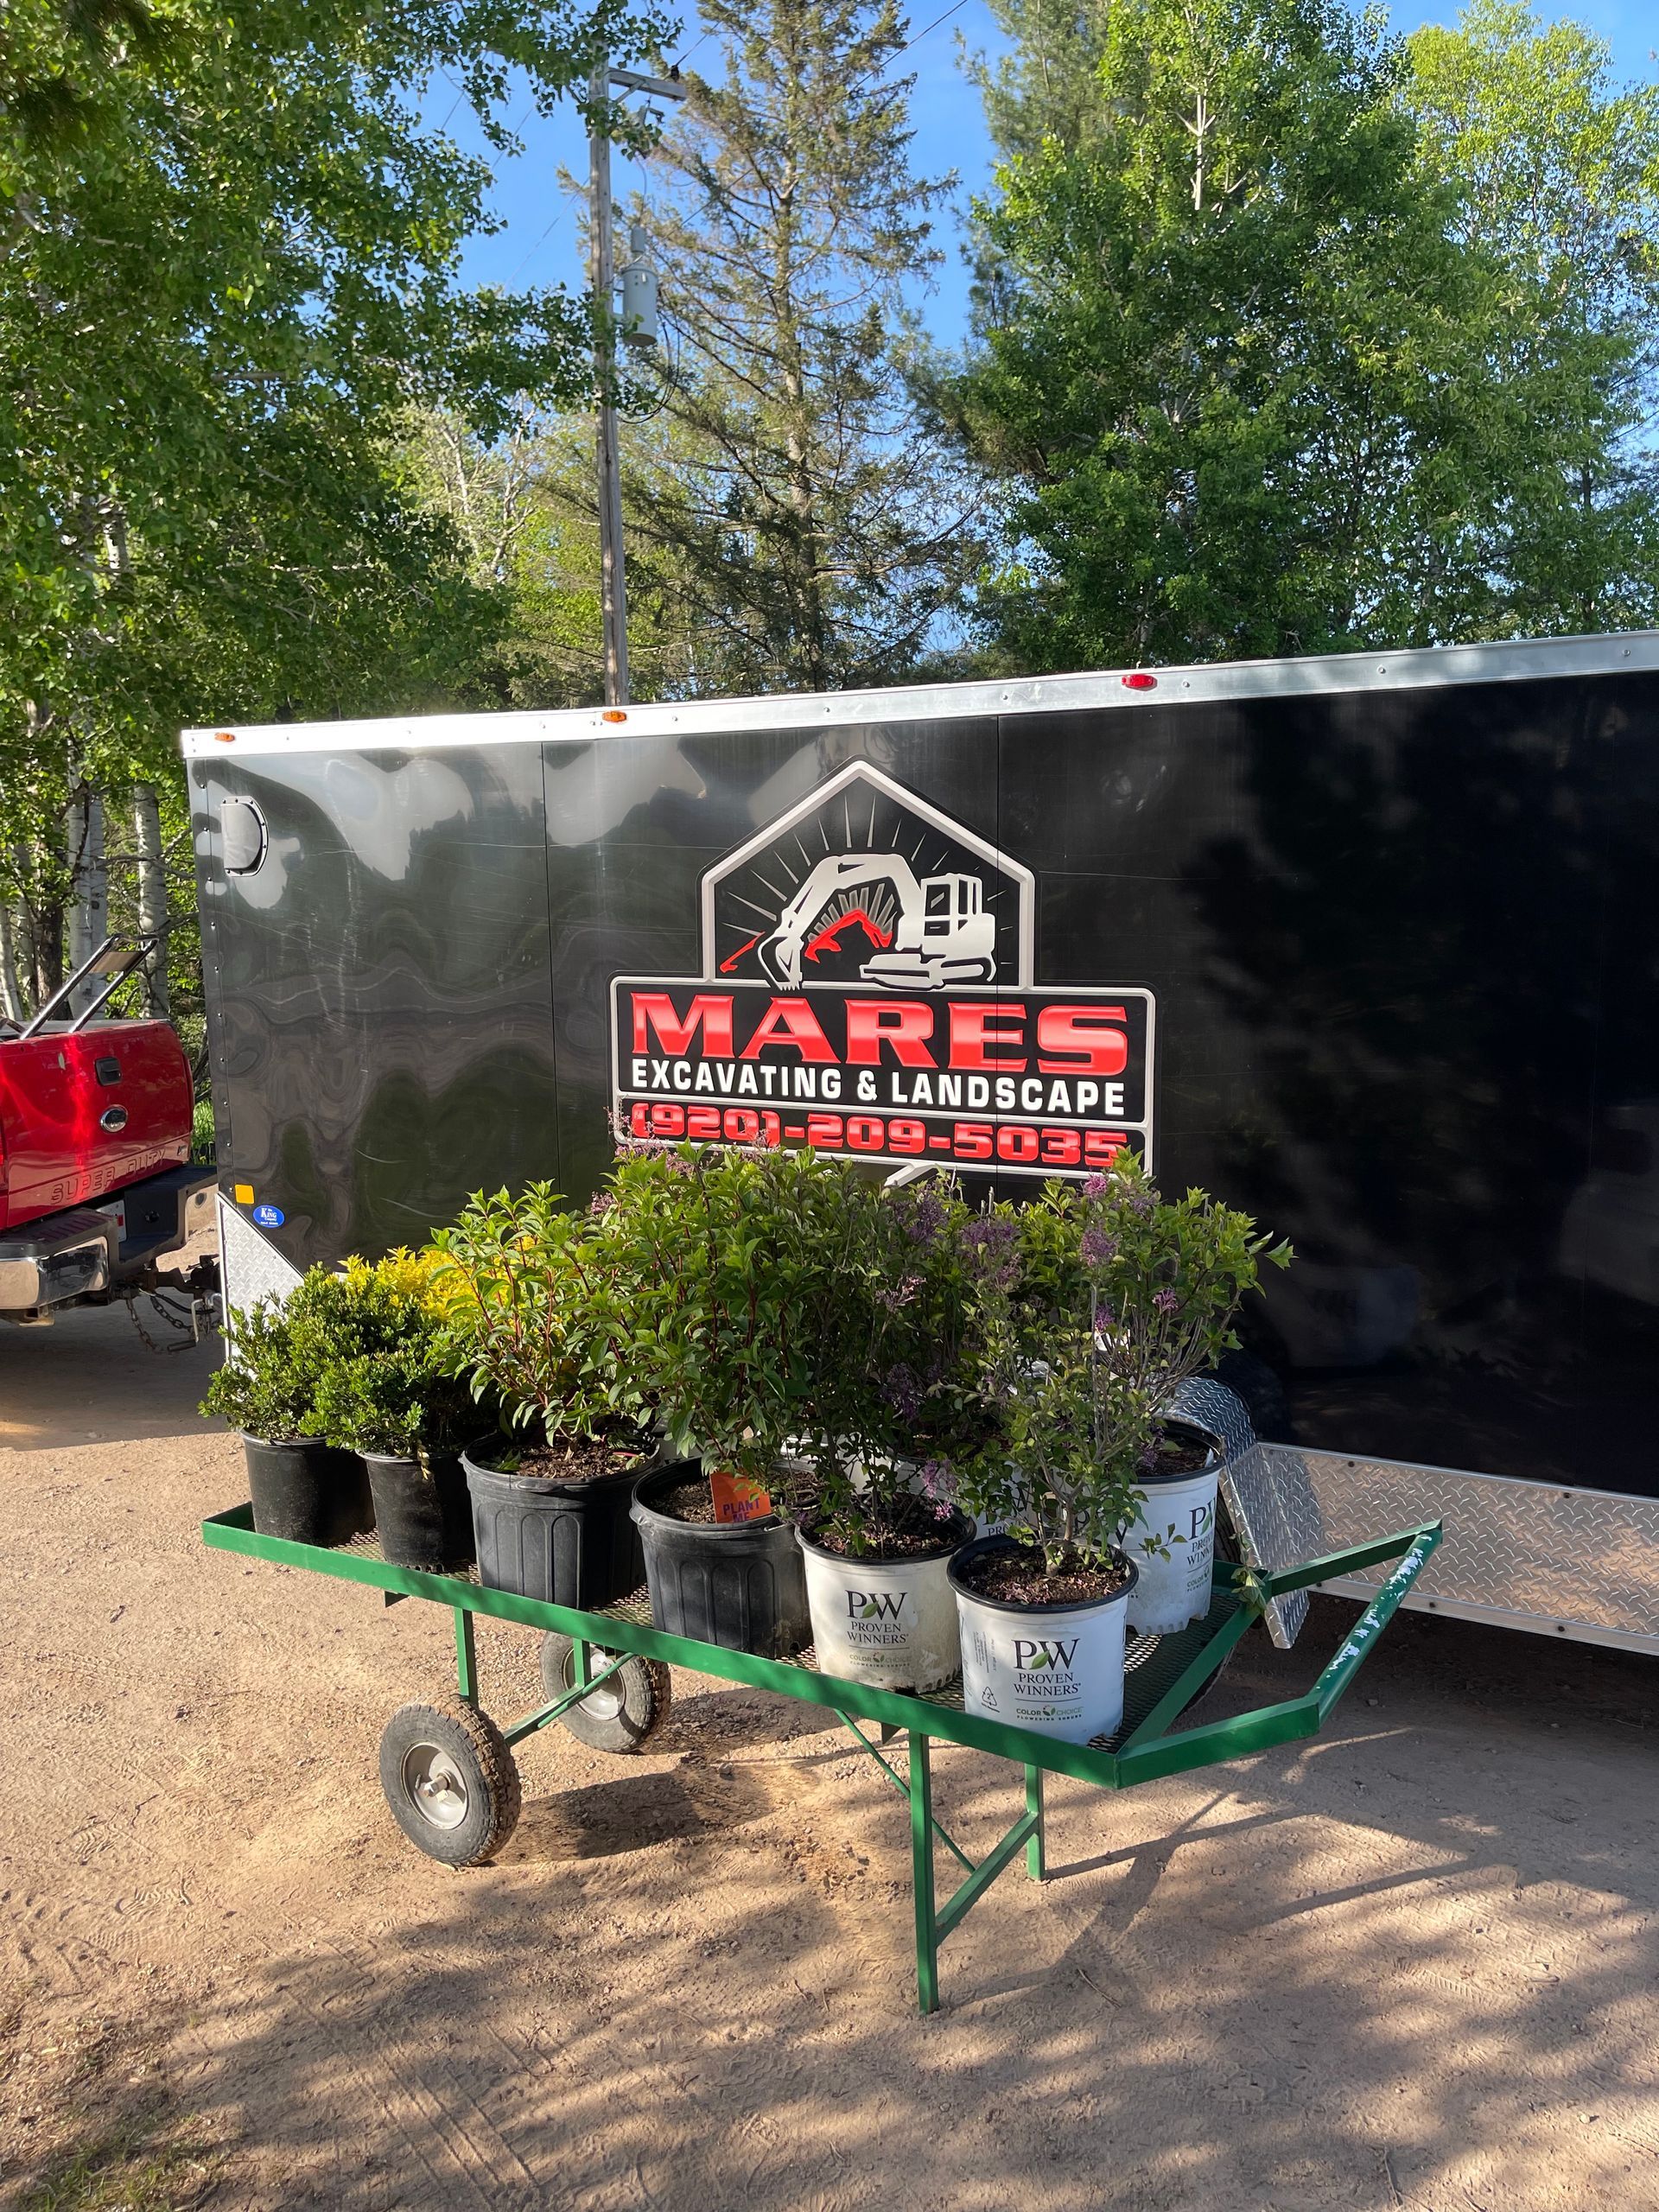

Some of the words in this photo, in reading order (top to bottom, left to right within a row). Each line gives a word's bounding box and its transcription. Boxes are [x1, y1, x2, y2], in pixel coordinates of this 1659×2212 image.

[631, 992, 1128, 1076] MARES
[632, 1058, 842, 1098] EXCAVATING
[856, 1070, 878, 1101] &
[892, 1071, 1125, 1116] LANDSCAPE
[632, 1103, 1127, 1166] (920)-209-5035
[51, 1166, 116, 1205] SUPER
[126, 1149, 166, 1176] DUTY
[722, 1498, 760, 1516] PLANT
[845, 1590, 908, 1620] PW
[847, 1631, 907, 1643] WINNERS
[851, 1621, 901, 1633] PROVEN
[1011, 1638, 1080, 1671] PW
[1014, 1683, 1079, 1696] WINNERS
[1018, 1672, 1074, 1684] PROVEN
[1016, 1707, 1041, 1716] COLOR
